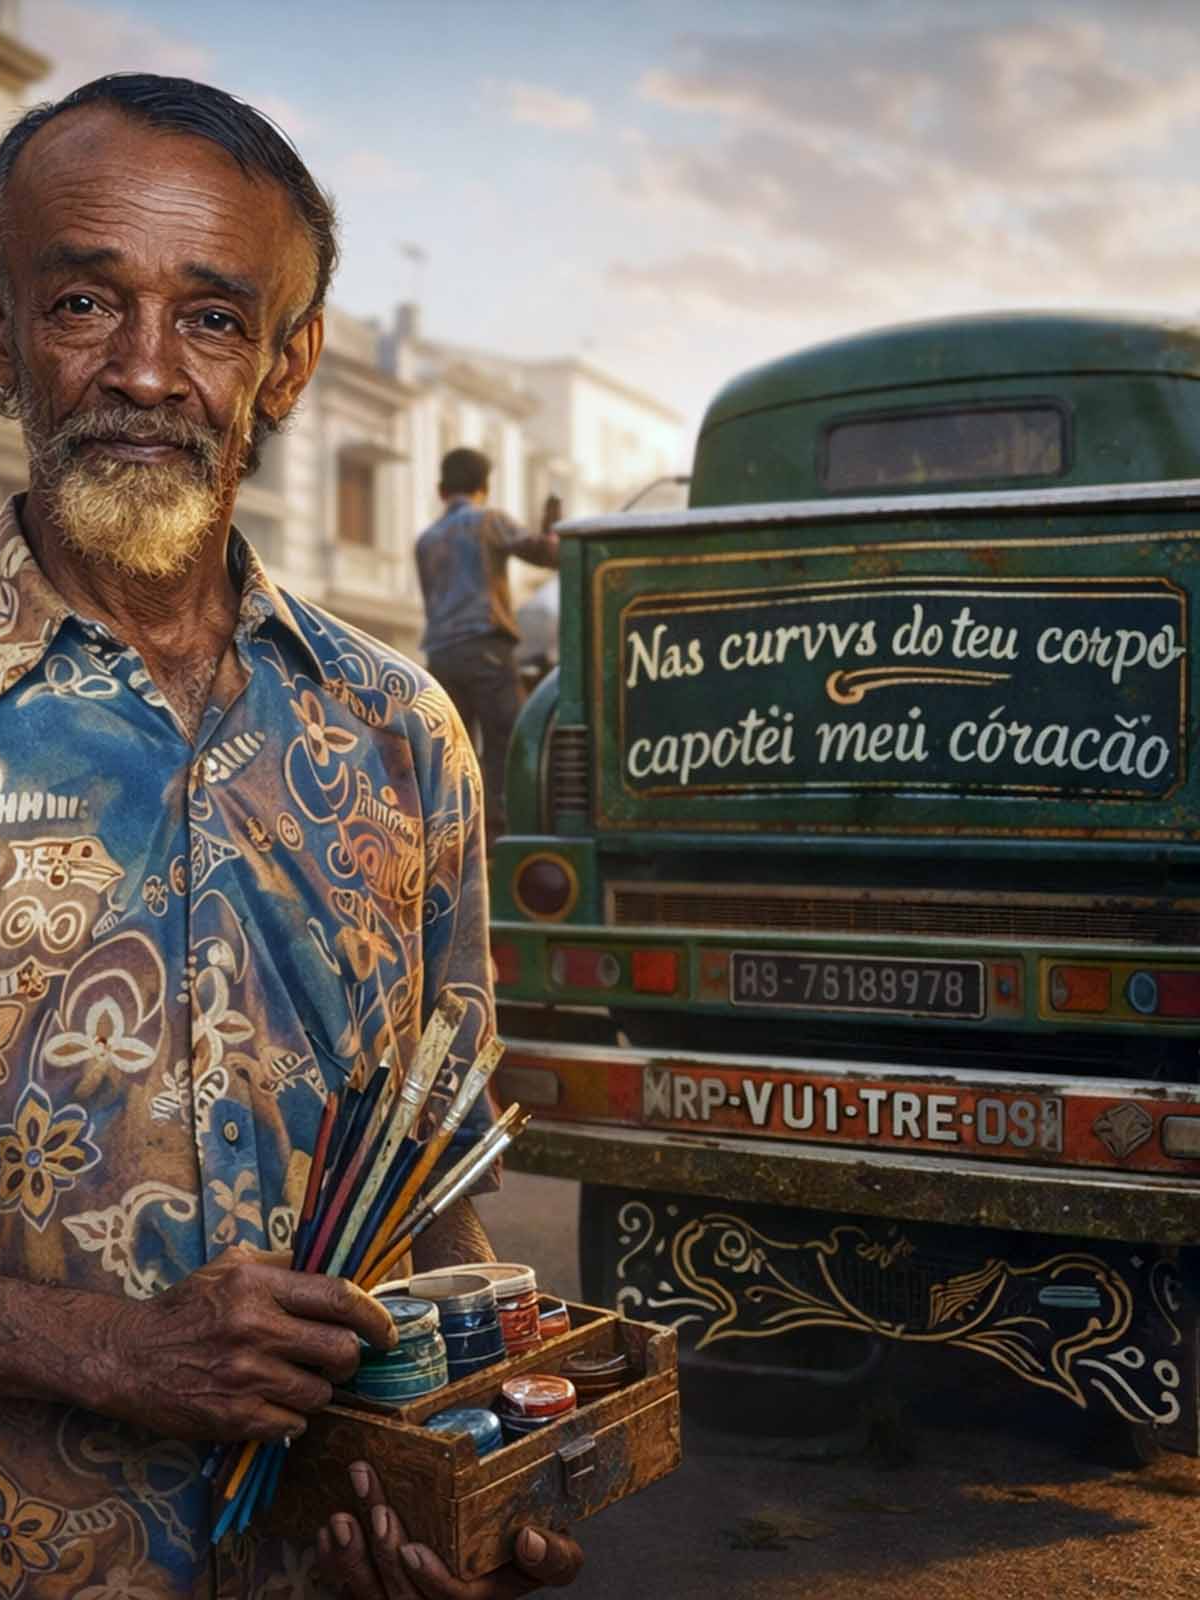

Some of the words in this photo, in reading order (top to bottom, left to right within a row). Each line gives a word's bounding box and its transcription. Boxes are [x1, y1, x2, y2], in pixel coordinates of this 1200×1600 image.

[627, 623, 705, 689] Nas
[891, 602, 944, 658] do
[951, 606, 1019, 660] teu
